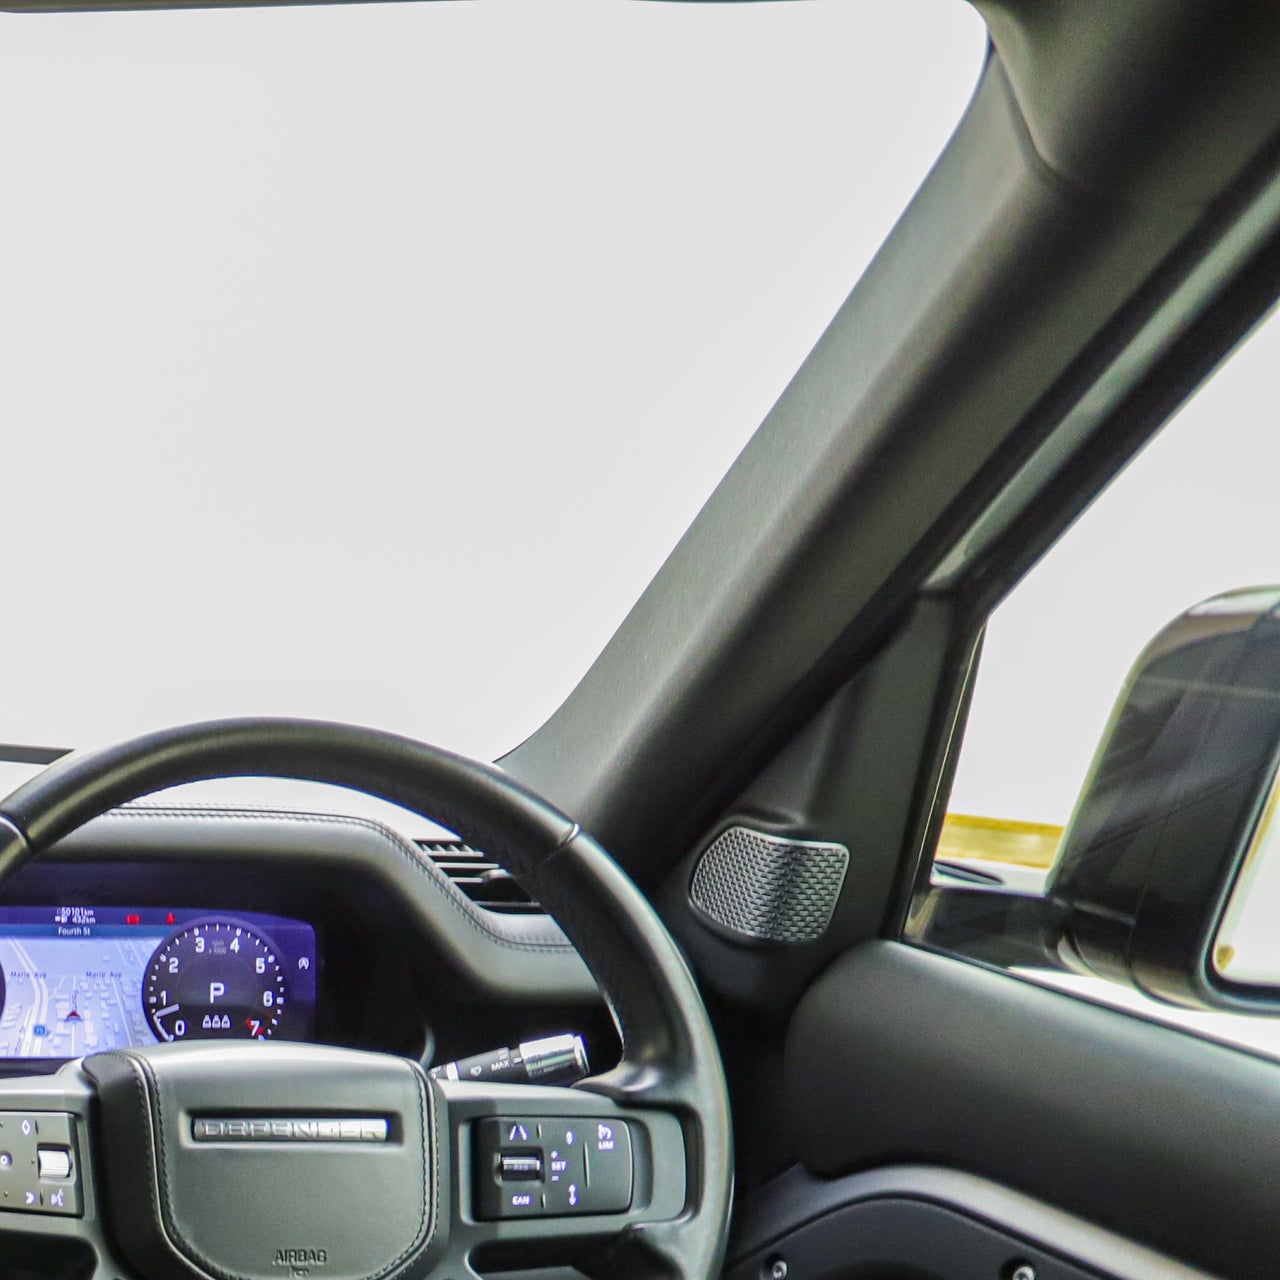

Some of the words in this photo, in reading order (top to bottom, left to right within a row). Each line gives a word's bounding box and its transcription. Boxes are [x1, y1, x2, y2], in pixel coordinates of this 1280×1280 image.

[58, 926, 82, 937] Fourth
[83, 926, 91, 937] St
[195, 937, 205, 953] 3
[229, 937, 240, 953] 4
[169, 957, 179, 973] 2
[255, 957, 266, 974] 5
[160, 990, 167, 1006] 1
[209, 982, 225, 1004] P
[263, 991, 273, 1007] 6
[175, 1020, 185, 1036] 0
[250, 1020, 260, 1036] 7
[490, 1059, 511, 1071] MAX
[598, 1141, 614, 1150] LIM
[551, 1161, 567, 1171] SET
[512, 1195, 530, 1206] CAN
[274, 1249, 327, 1265] AIRBAG
